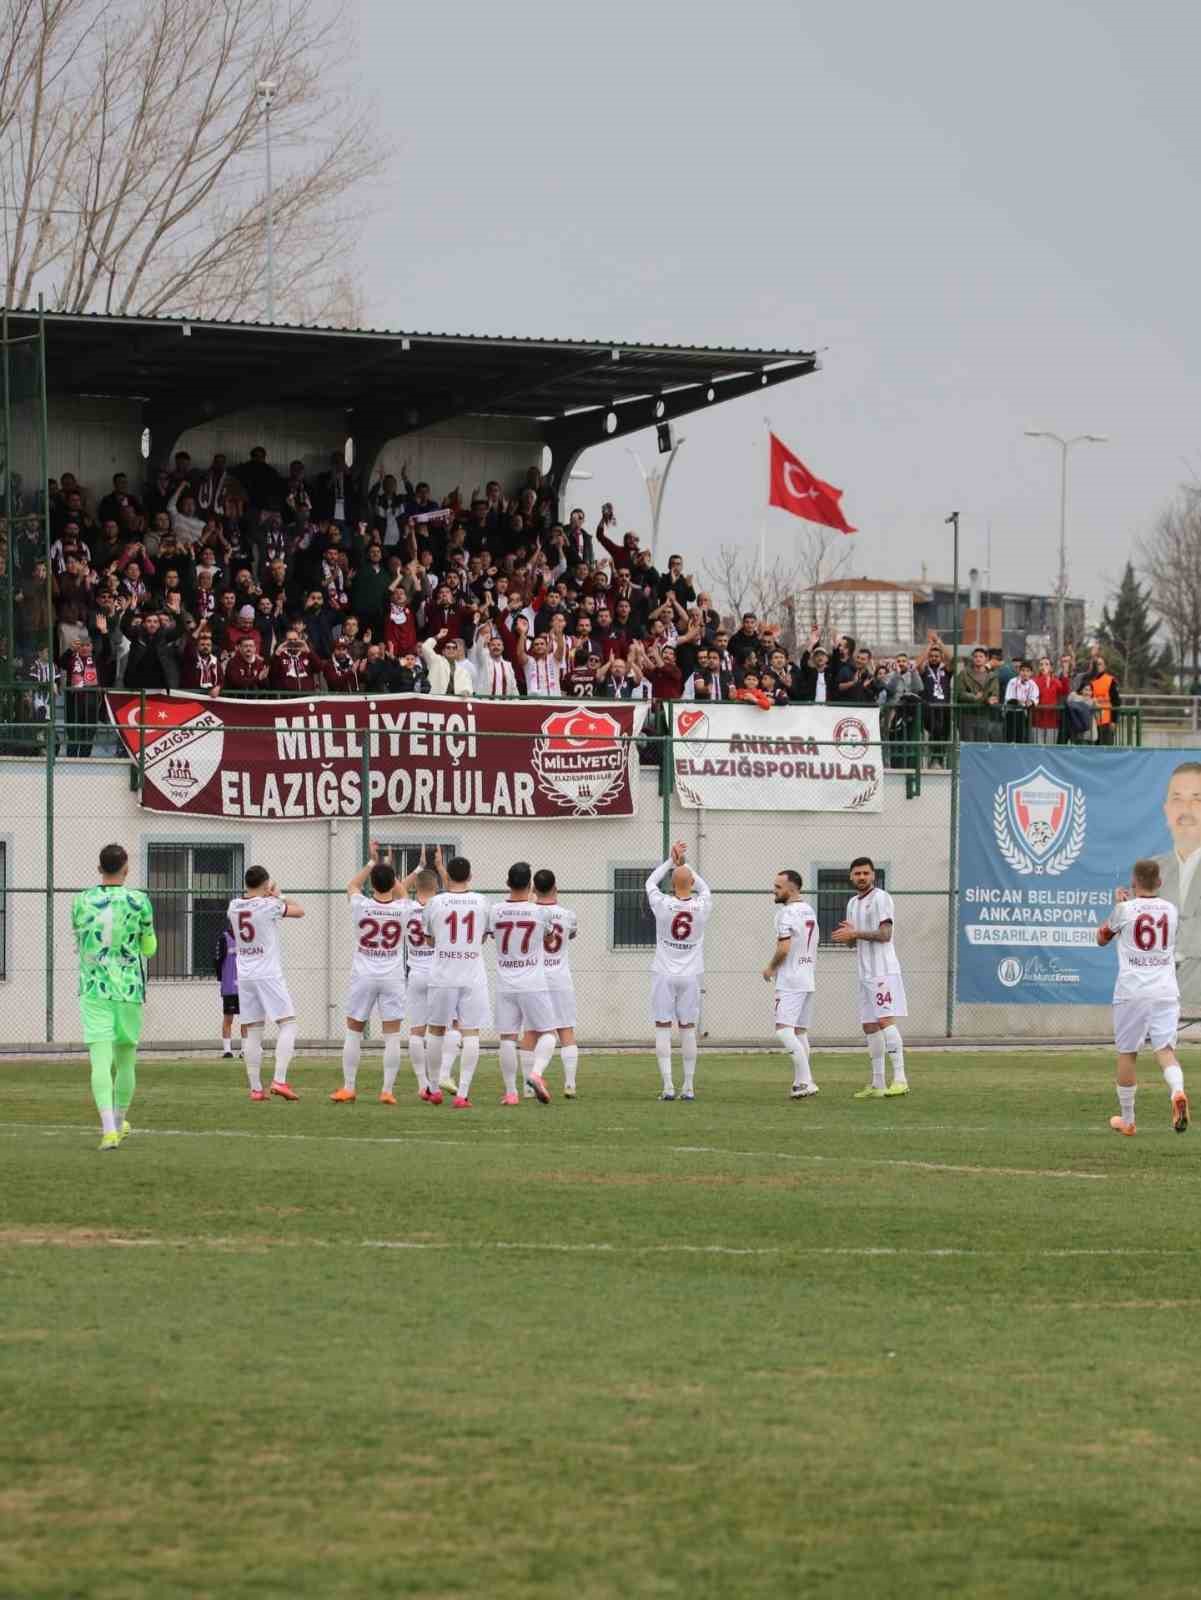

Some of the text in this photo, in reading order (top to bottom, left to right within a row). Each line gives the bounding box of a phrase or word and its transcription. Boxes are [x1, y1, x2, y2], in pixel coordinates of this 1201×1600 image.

[274, 702, 477, 766] MİLLİYETÇİ
[728, 733, 820, 756] ANKARA
[544, 752, 621, 769] MİLLİYETÇİ
[676, 758, 876, 781] ELAZIĞSPORLULAR
[220, 762, 536, 817] ELAZIĞSPORLULAR
[965, 886, 1112, 905] SİNCAN BELEDİYESİ
[238, 910, 256, 943] 5
[445, 910, 475, 944] 11
[671, 911, 693, 941] 6
[979, 907, 1097, 923] ANKARASPOR'A
[358, 918, 402, 949] 29
[495, 921, 537, 955] 77
[805, 920, 816, 953] 7
[1134, 913, 1169, 951] 61
[876, 992, 892, 1006] 34
